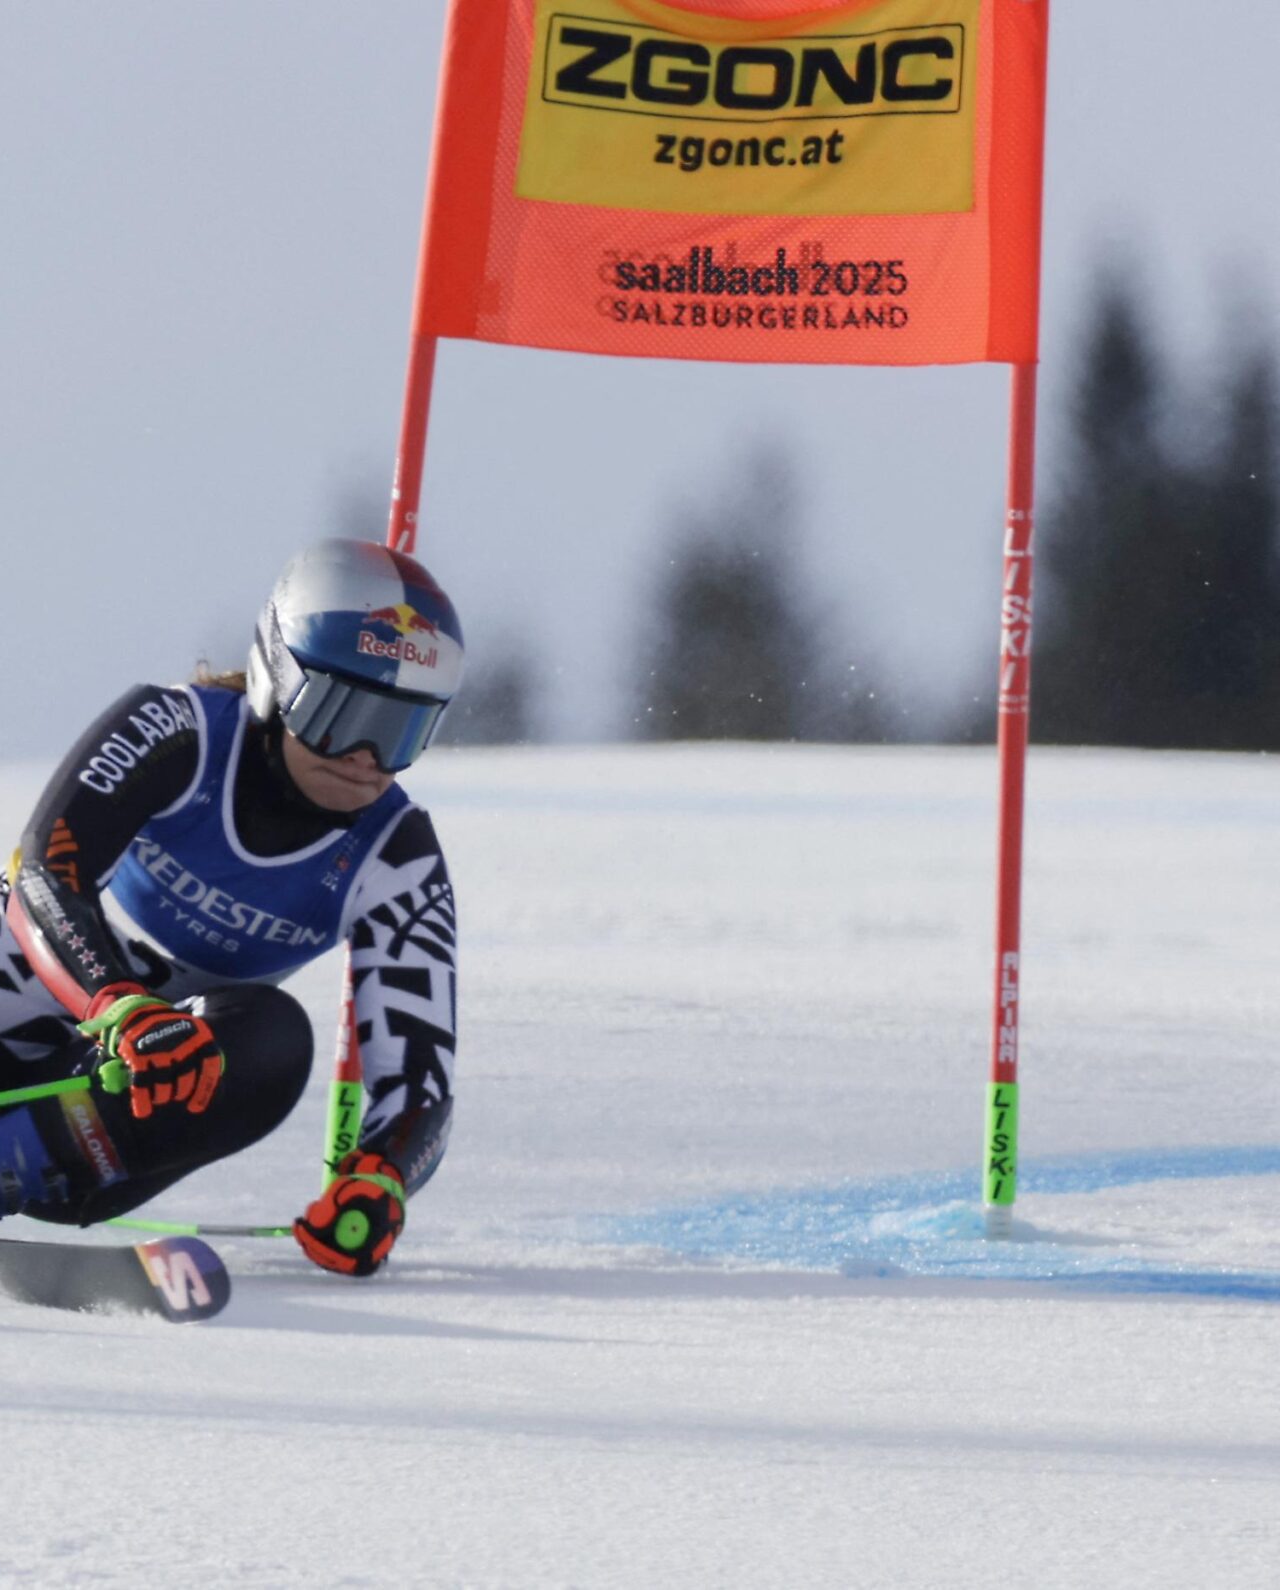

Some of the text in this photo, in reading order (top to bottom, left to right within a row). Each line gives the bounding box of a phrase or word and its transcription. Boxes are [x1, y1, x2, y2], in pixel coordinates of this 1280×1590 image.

[554, 27, 955, 110] ZGONC
[653, 129, 845, 171] zgonc.at
[615, 246, 908, 296] saalbach 2025
[613, 300, 909, 330] SALZBURGERLAND
[357, 630, 438, 669] Red Bull
[158, 896, 240, 952] TYRES
[137, 1019, 191, 1049] reusch
[998, 951, 1019, 1064] ALPINA
[332, 1086, 355, 1172] LIS
[988, 1088, 1011, 1200] LISKI
